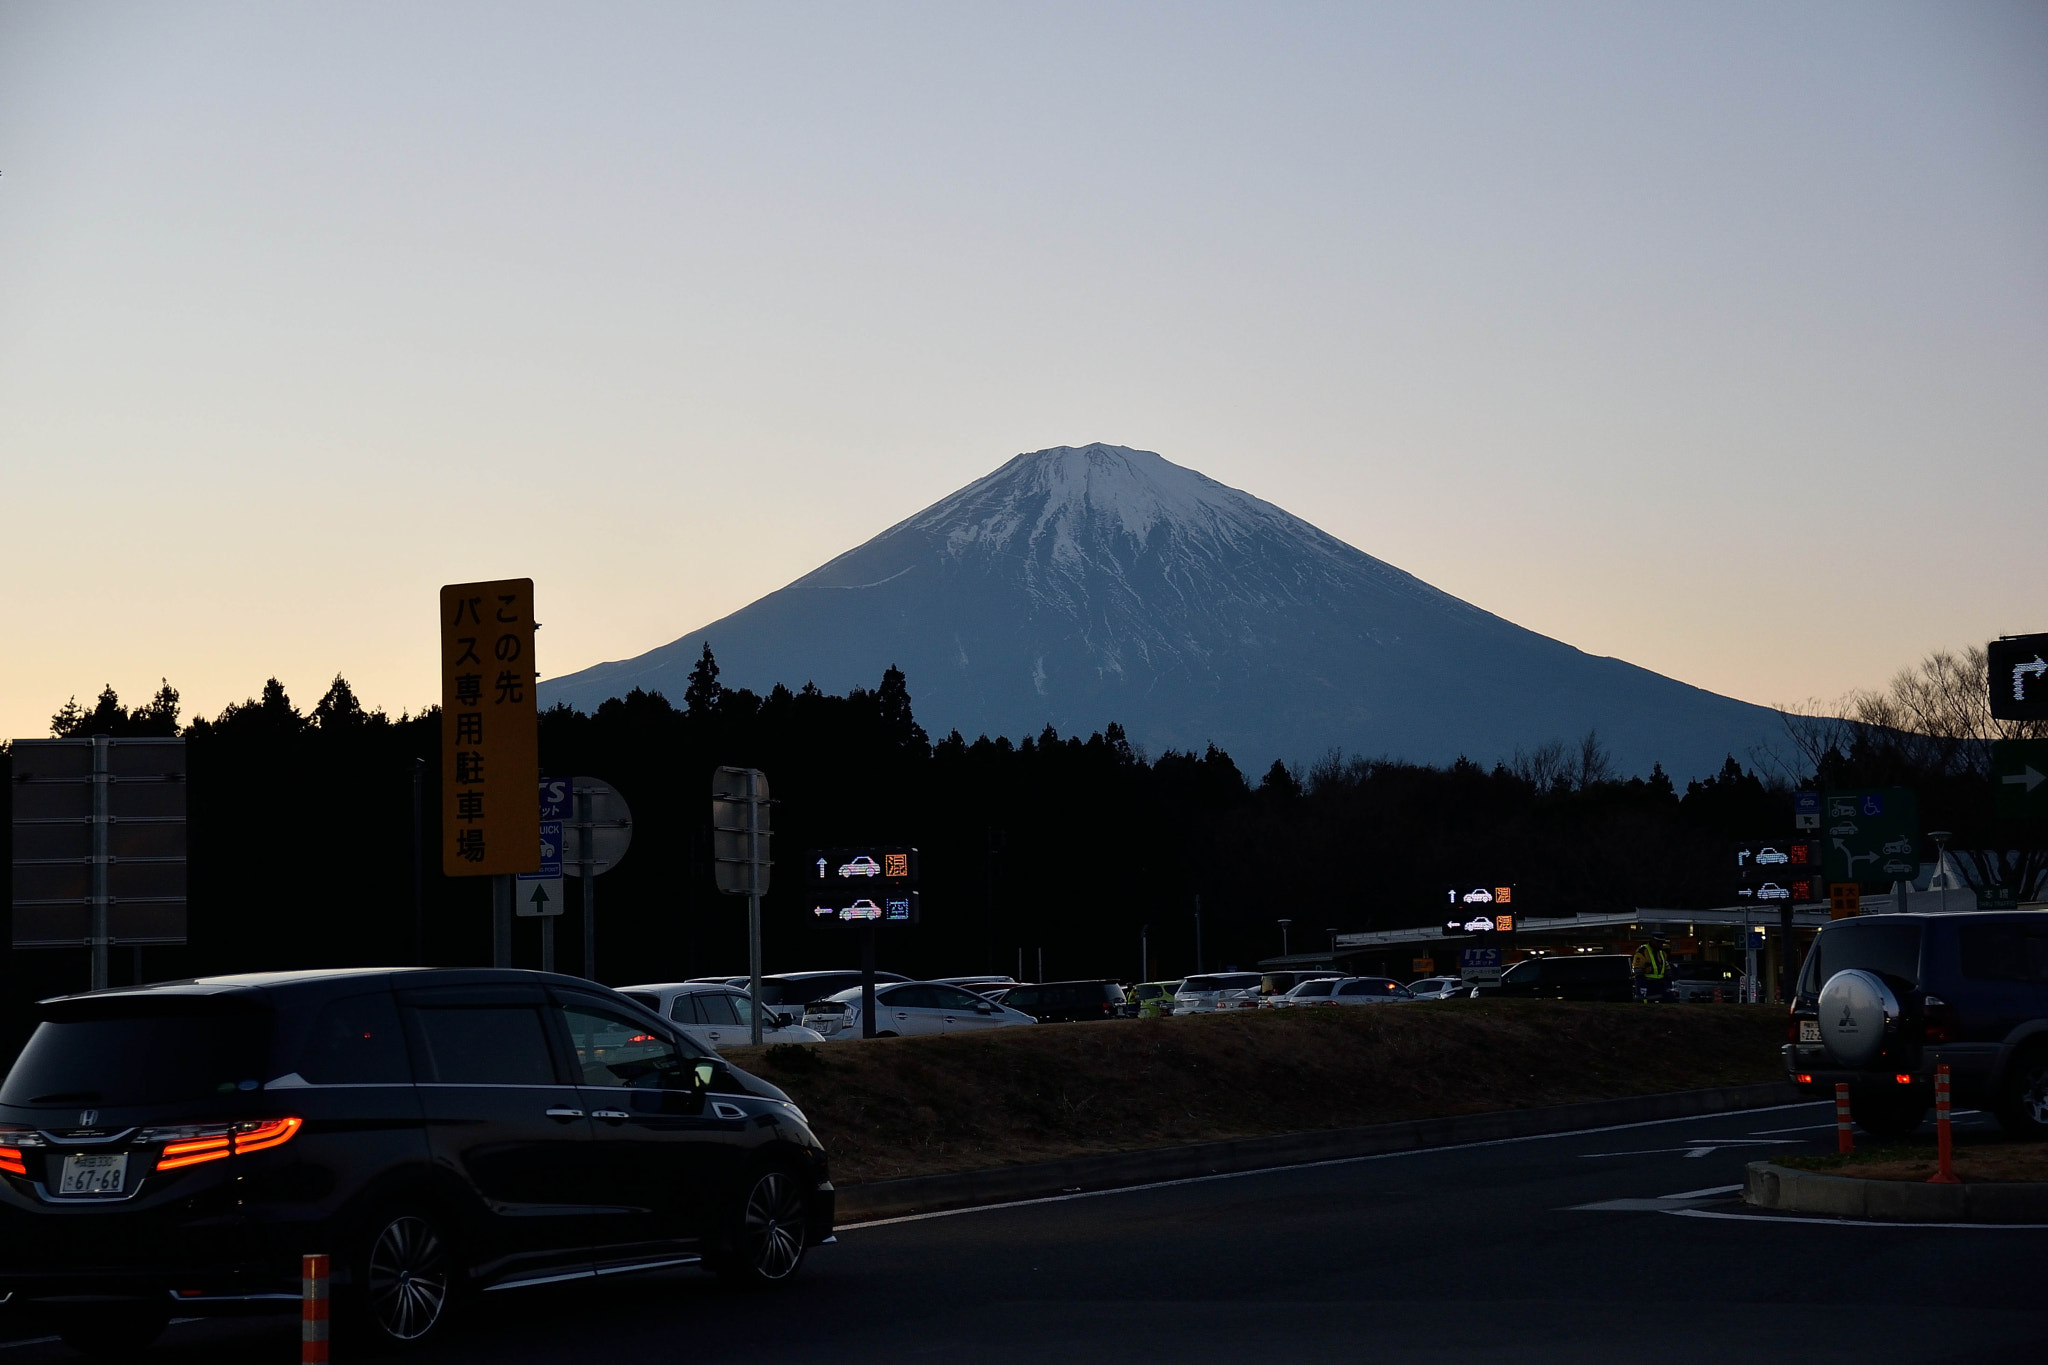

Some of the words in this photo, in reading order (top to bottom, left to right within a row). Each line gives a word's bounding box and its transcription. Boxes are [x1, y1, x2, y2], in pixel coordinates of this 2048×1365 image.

[495, 594, 523, 704] この先
[454, 596, 485, 862] バス専用駐車場
[540, 825, 560, 835] UICK
[1465, 949, 1497, 960] ITS
[76, 1169, 120, 1189] 67-68
